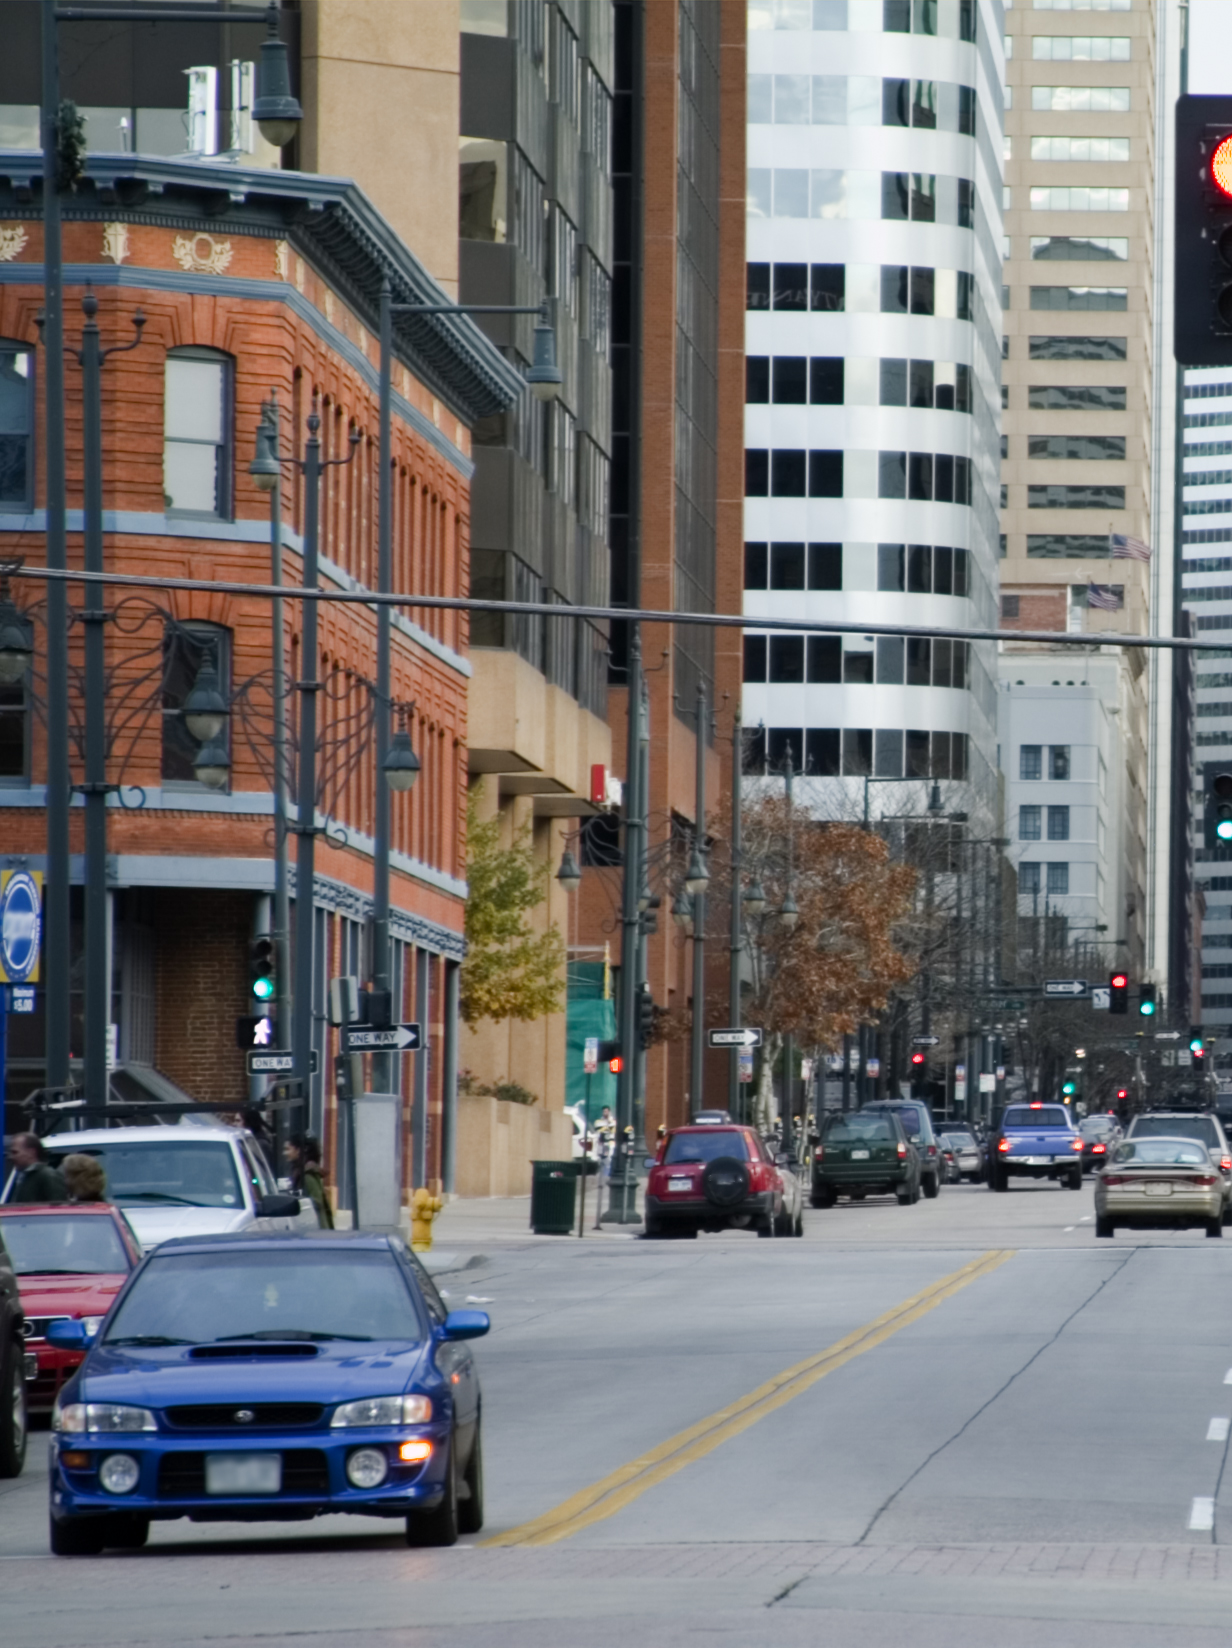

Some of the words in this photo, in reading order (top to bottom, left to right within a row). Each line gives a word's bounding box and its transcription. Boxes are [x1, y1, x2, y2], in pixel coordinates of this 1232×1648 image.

[349, 1034, 370, 1043] ONE
[374, 1033, 397, 1043] WAY
[255, 1058, 274, 1067] ONE
